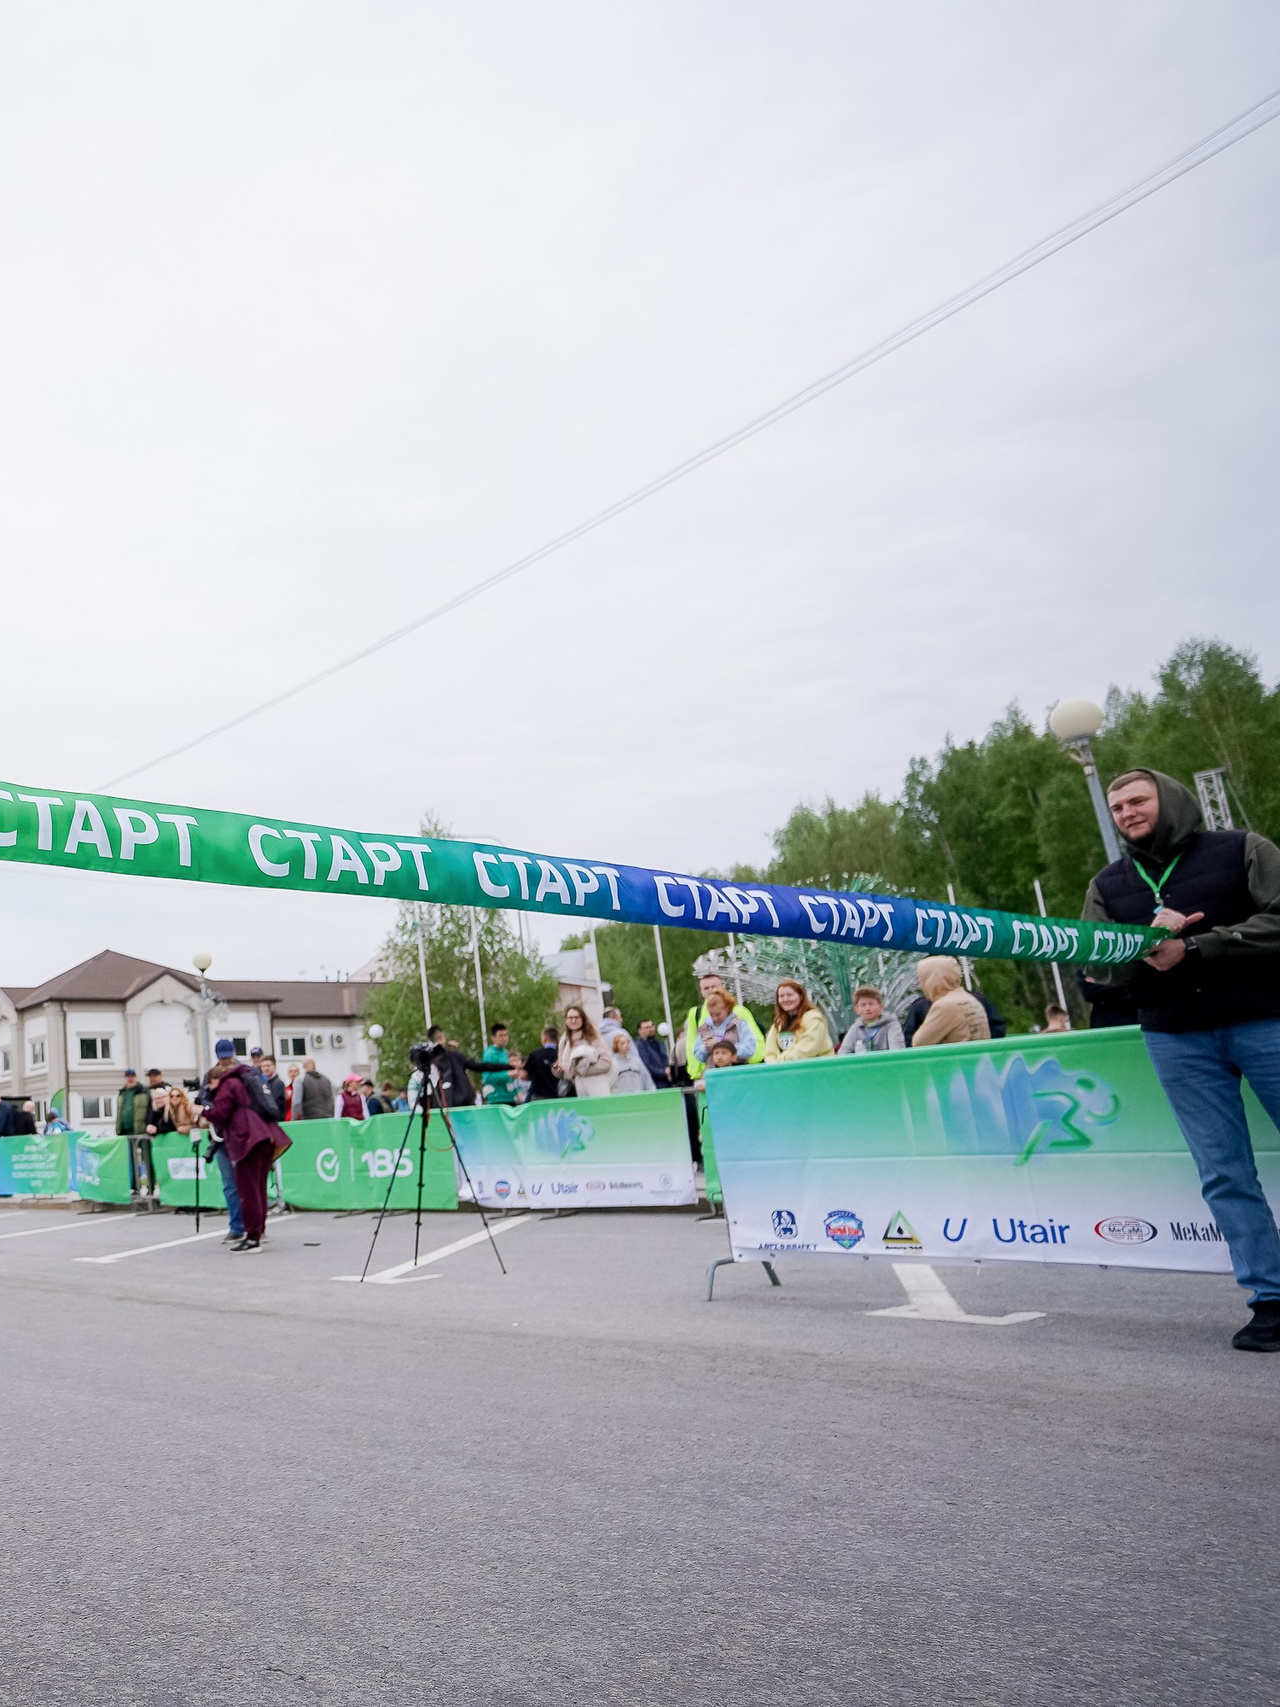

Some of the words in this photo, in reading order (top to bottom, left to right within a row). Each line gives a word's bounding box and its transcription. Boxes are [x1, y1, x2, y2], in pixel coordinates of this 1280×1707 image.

[247, 823, 432, 891] СТАРТ
[472, 851, 621, 911] СТАРТ
[652, 875, 780, 929] СТАРТ
[798, 894, 895, 942] СТАРТ
[915, 907, 995, 953] СТАРТ
[1011, 920, 1080, 960] СТАРТ
[1093, 930, 1144, 962] СТАРТ
[362, 1148, 414, 1178] 185
[992, 1217, 1070, 1245] Utair
